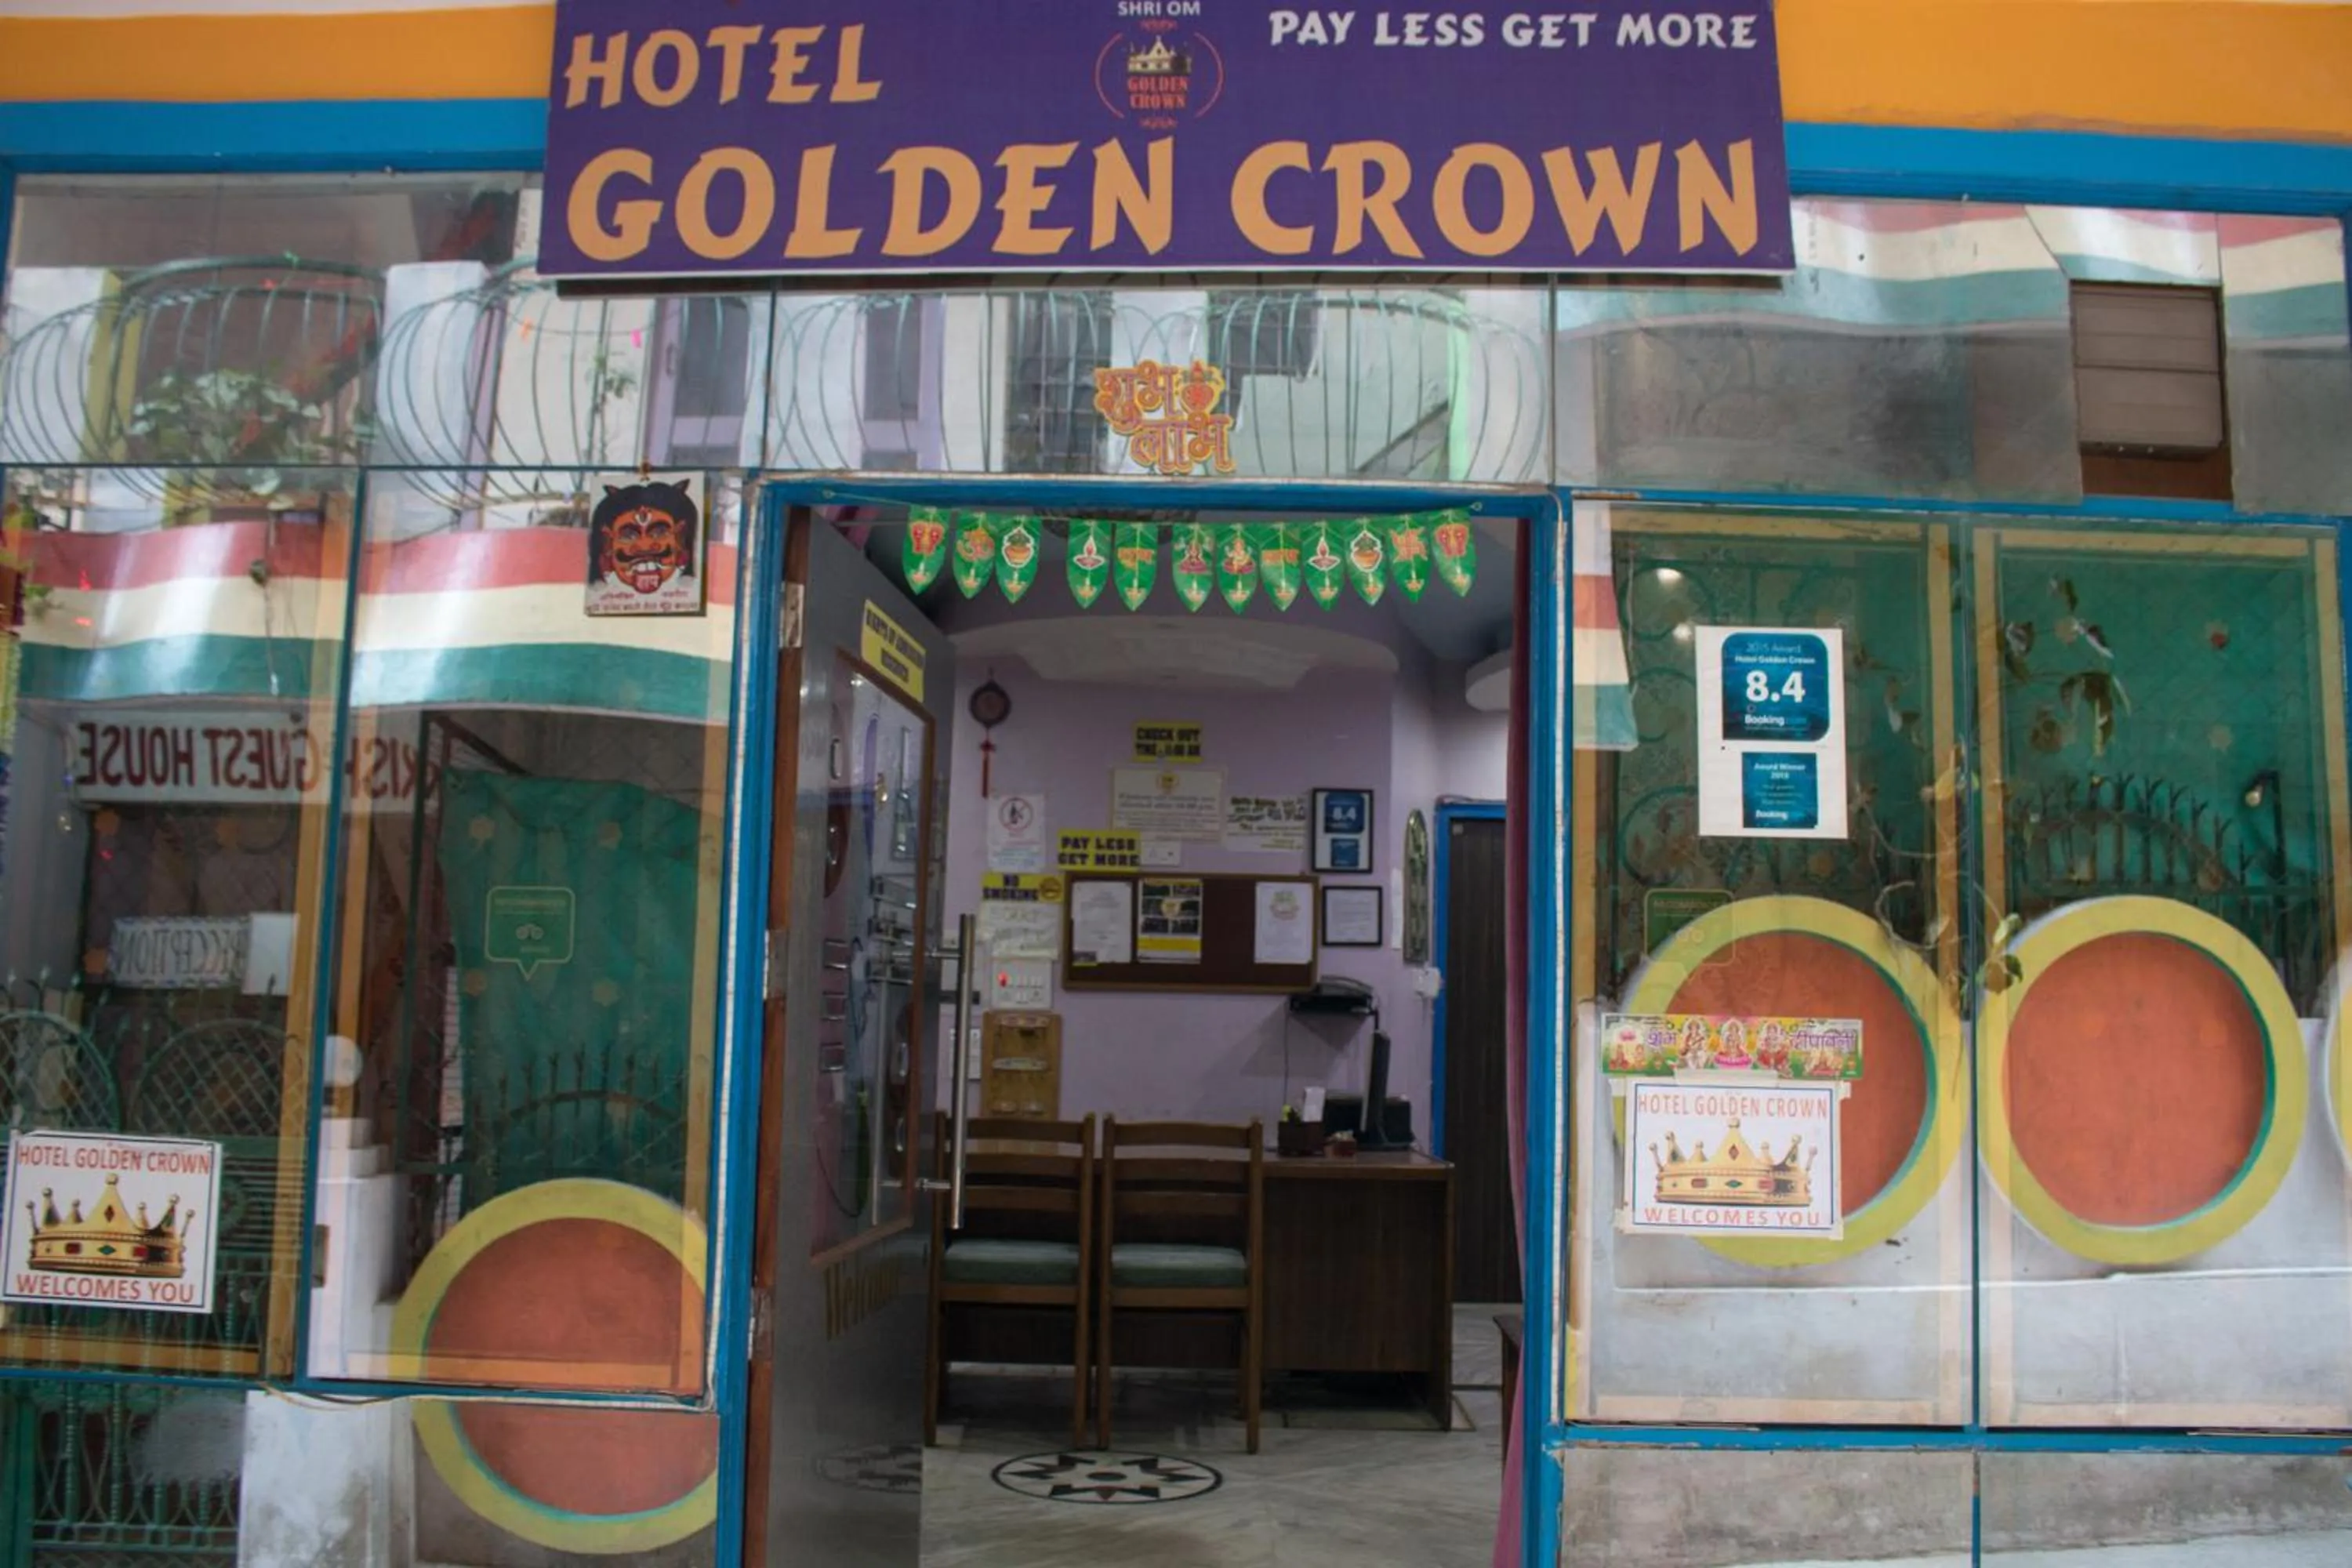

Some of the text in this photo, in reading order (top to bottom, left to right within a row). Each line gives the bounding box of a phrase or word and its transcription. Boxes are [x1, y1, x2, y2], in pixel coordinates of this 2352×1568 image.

[1117, 0, 1201, 16] SHRI OM
[1269, 10, 1759, 49] PAY LESS GET MORE
[563, 23, 884, 109] HOTEL
[1127, 76, 1189, 93] GOLDEN
[1129, 93, 1186, 110] CROWN
[567, 135, 1759, 262] GOLDEN CROWN
[1745, 669, 1806, 703] 8.4
[1061, 836, 1136, 851] PAY LESS
[1058, 852, 1141, 867] GET MORE
[1638, 1093, 1828, 1120] HOTEL GOLDEN CROWN
[17, 1145, 210, 1174] HOTEL GOLDEN CROWN
[1645, 1207, 1820, 1227] WELCOMES YOU
[16, 1273, 195, 1303] WELCOMES YOU
